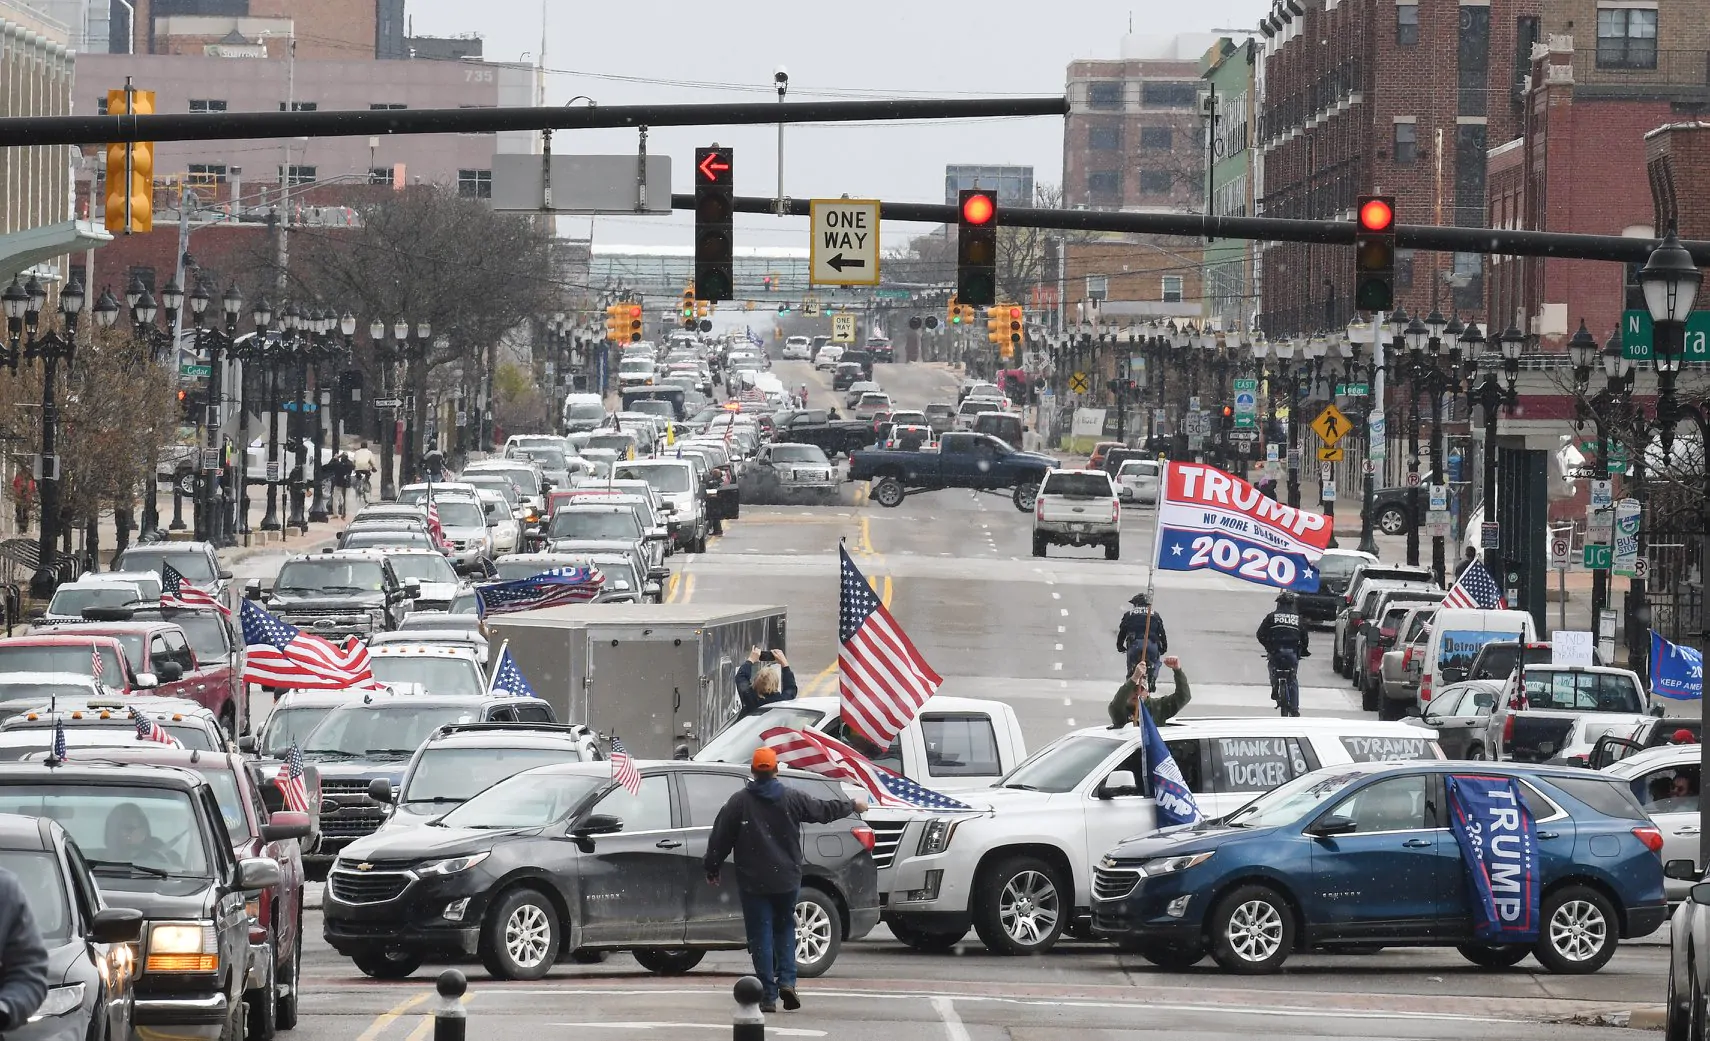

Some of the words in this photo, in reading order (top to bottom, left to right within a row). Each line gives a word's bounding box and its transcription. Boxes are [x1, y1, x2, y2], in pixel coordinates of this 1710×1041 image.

[464, 69, 493, 82] 735
[826, 210, 867, 229] ONE
[824, 231, 868, 249] WAY
[1629, 315, 1640, 334] N
[1629, 345, 1648, 355] 100
[1683, 331, 1706, 354] ra
[187, 366, 208, 375] Cedar
[1237, 381, 1253, 389] EAST
[1179, 465, 1325, 537] TRUMP
[1203, 512, 1217, 525] NO
[1220, 516, 1249, 532] MORE
[1616, 533, 1637, 547] BUS
[1618, 543, 1638, 554] STOP
[1189, 536, 1296, 586] 2020
[1585, 548, 1611, 565] JC
[1274, 617, 1299, 626] POLICE
[1555, 631, 1587, 645] END
[1660, 678, 1682, 688] KEEP
[1219, 738, 1270, 758] THANK
[1273, 738, 1289, 759] U
[1345, 737, 1425, 755] TYRANNY
[1223, 760, 1288, 787] TUCKER
[1155, 787, 1193, 817] UMP
[1488, 785, 1521, 922] TRUMP
